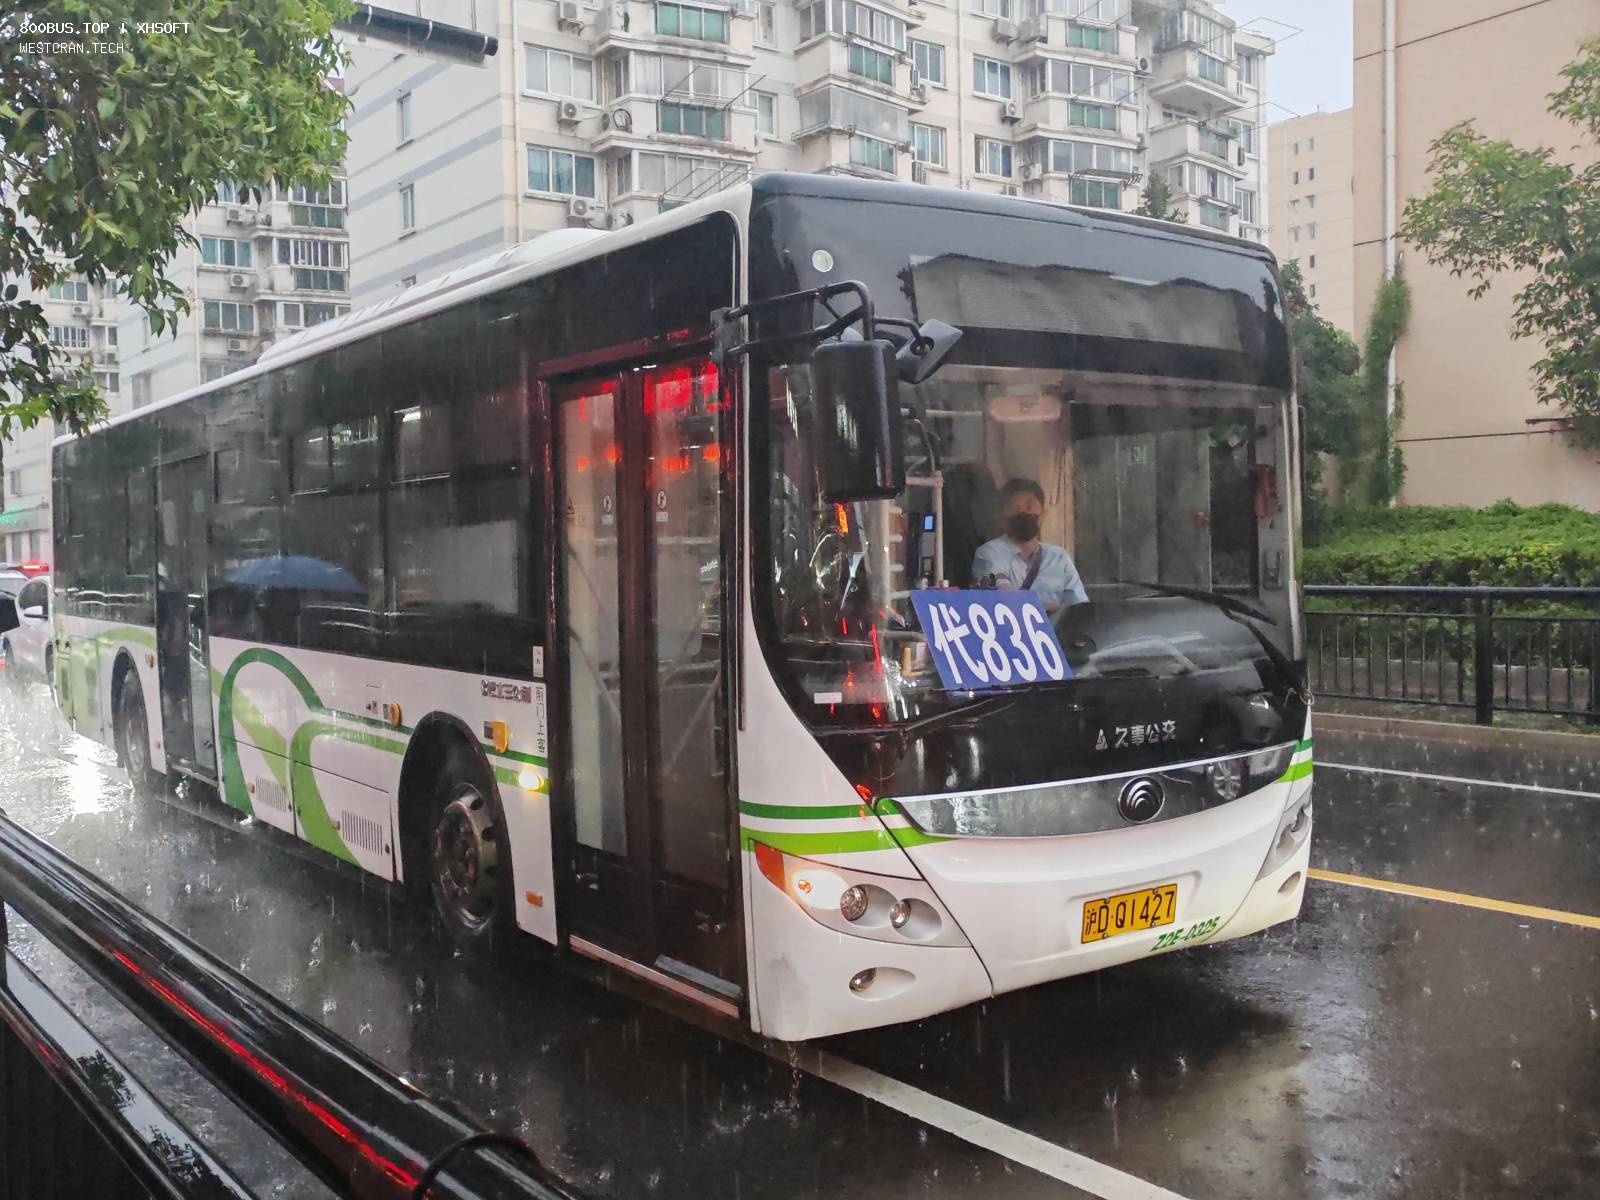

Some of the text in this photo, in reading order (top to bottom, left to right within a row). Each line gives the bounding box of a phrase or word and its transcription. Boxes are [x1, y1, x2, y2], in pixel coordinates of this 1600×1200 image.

[929, 602, 1064, 684] 代836
[1114, 719, 1177, 749] 久事公交
